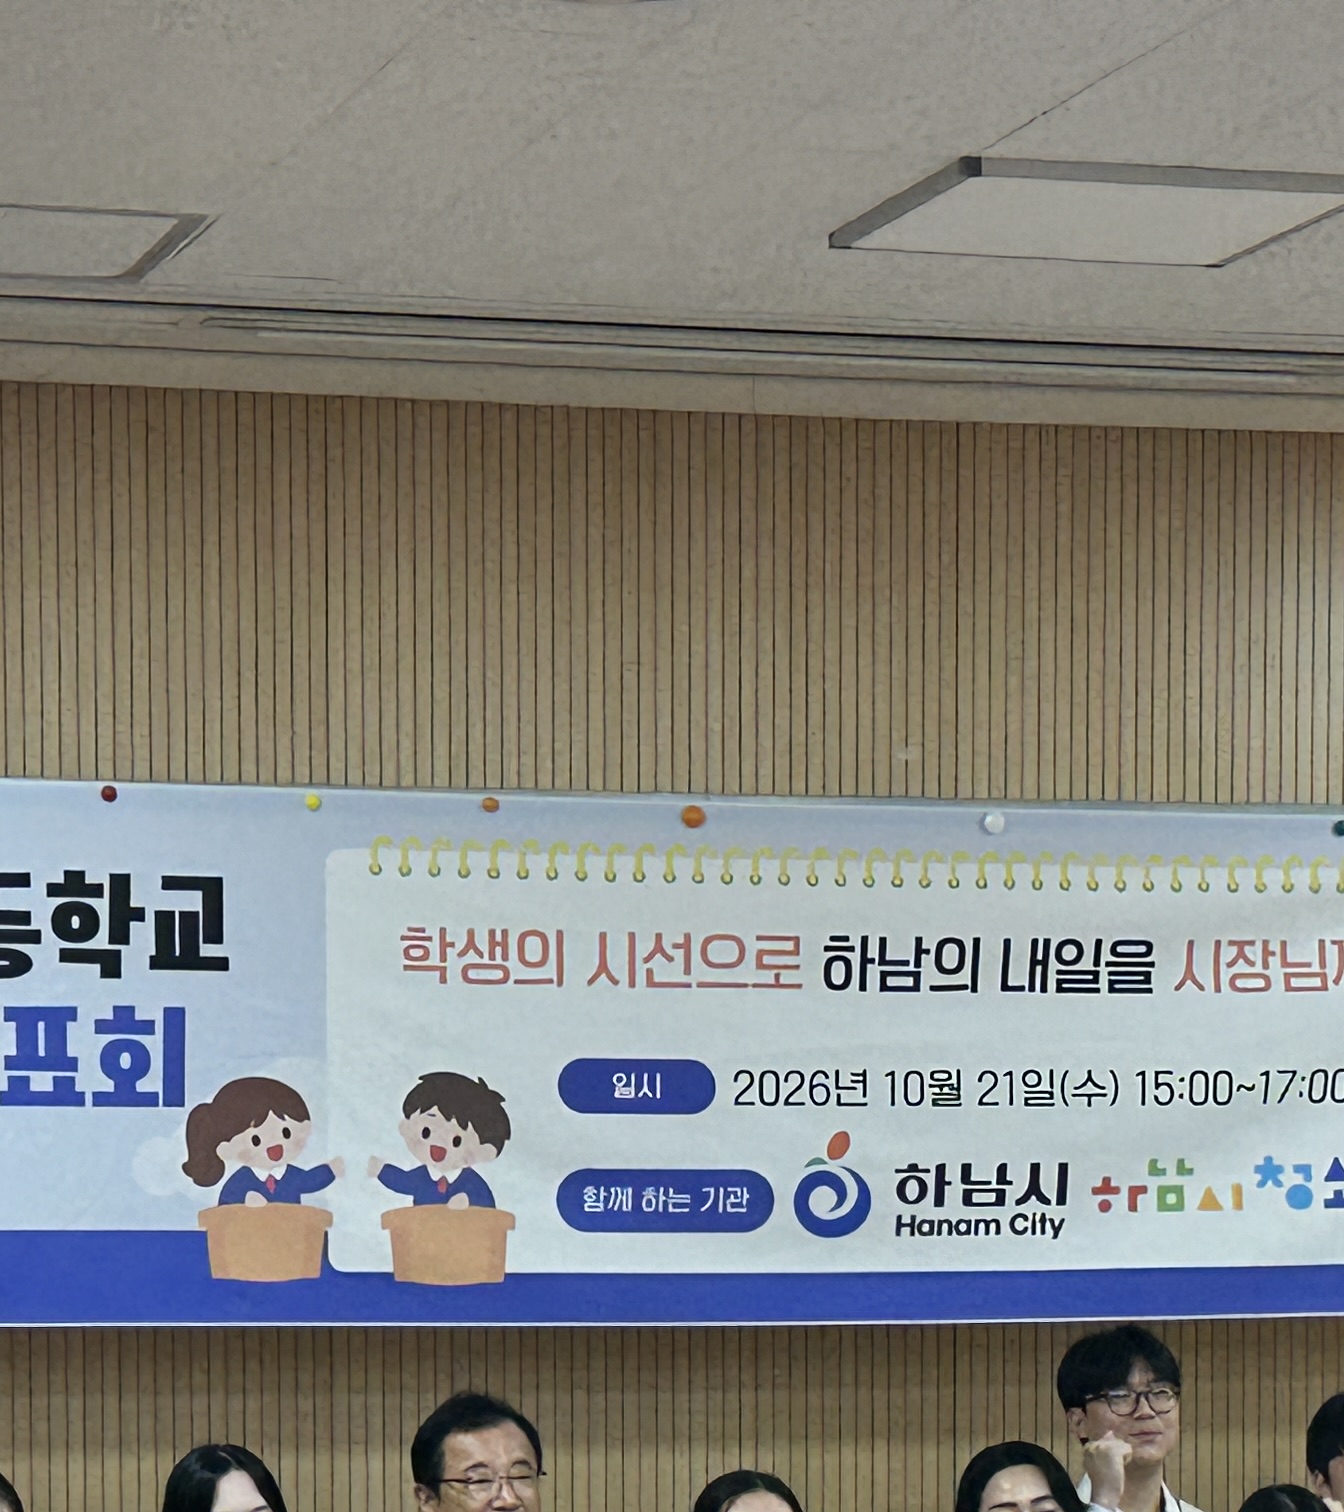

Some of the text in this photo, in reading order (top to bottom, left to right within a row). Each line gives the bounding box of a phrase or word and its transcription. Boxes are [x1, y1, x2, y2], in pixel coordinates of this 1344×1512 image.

[400, 927, 564, 987] 학생의
[587, 932, 803, 989] 시선으로
[824, 935, 980, 993] 하남의
[1001, 938, 1155, 994] 내일을
[613, 1073, 660, 1098] 일시
[734, 1069, 868, 1106] 2026년
[885, 1069, 962, 1107] 10월
[978, 1069, 1118, 1107] 21일(수)
[584, 1186, 749, 1213] 함께 하는 기관
[895, 1162, 1068, 1207] 하남시
[896, 1212, 1065, 1239] Hanam City
